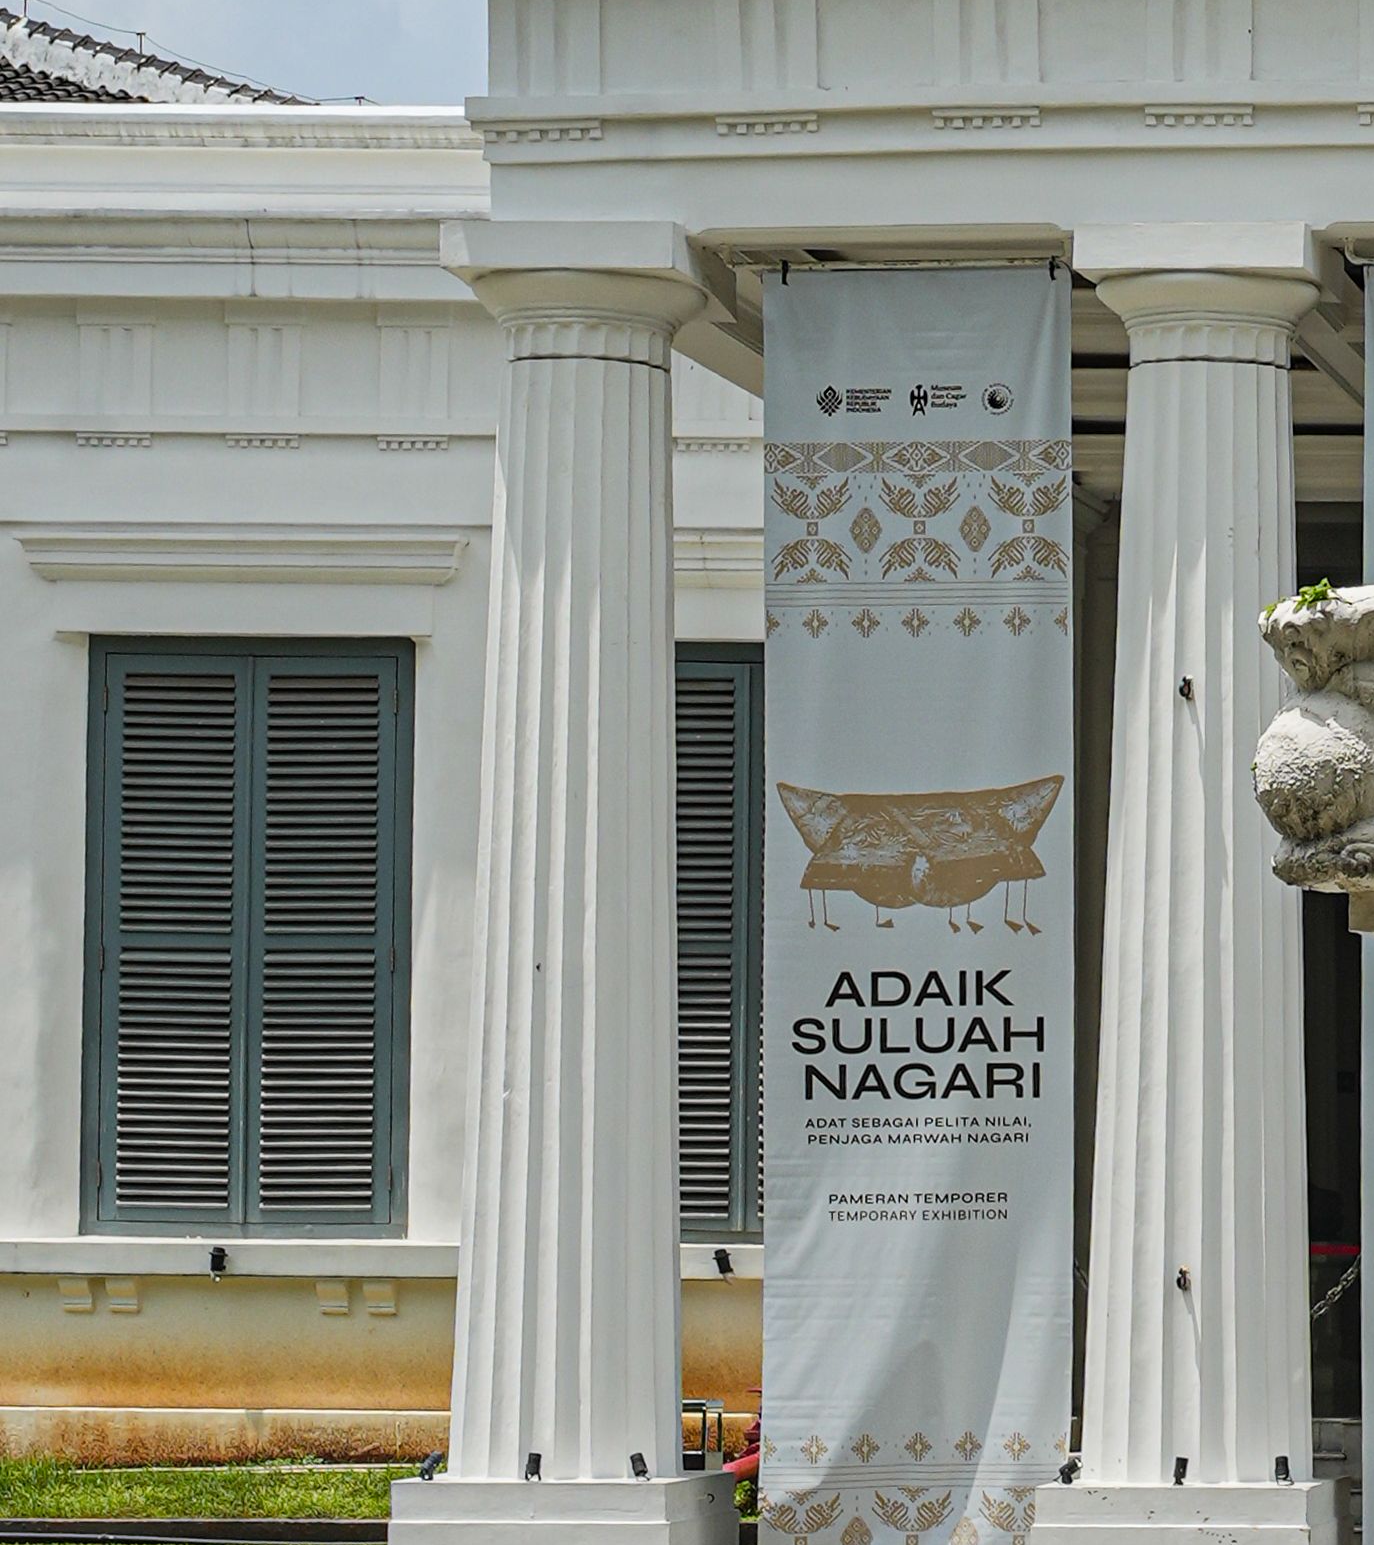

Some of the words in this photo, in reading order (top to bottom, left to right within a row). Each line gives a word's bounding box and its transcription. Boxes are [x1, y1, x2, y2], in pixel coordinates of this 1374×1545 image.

[824, 969, 1014, 1008] ADAIK
[791, 1016, 1046, 1055] SULUAH
[804, 1062, 1040, 1101] NAGARI
[805, 1118, 846, 1128] ADAT
[851, 1118, 919, 1128] SEBAGAI
[924, 1116, 980, 1127] PELITA
[985, 1116, 1033, 1129] NILAI,
[807, 1134, 883, 1145] PENJAGA
[888, 1133, 962, 1144] MARWAH
[966, 1132, 1030, 1144] NAGARI
[828, 1193, 909, 1205] PAMERAN
[914, 1192, 1008, 1204] TEMPORER
[828, 1210, 918, 1222] TEMPORARY
[922, 1208, 1008, 1221] EXHIBITION
